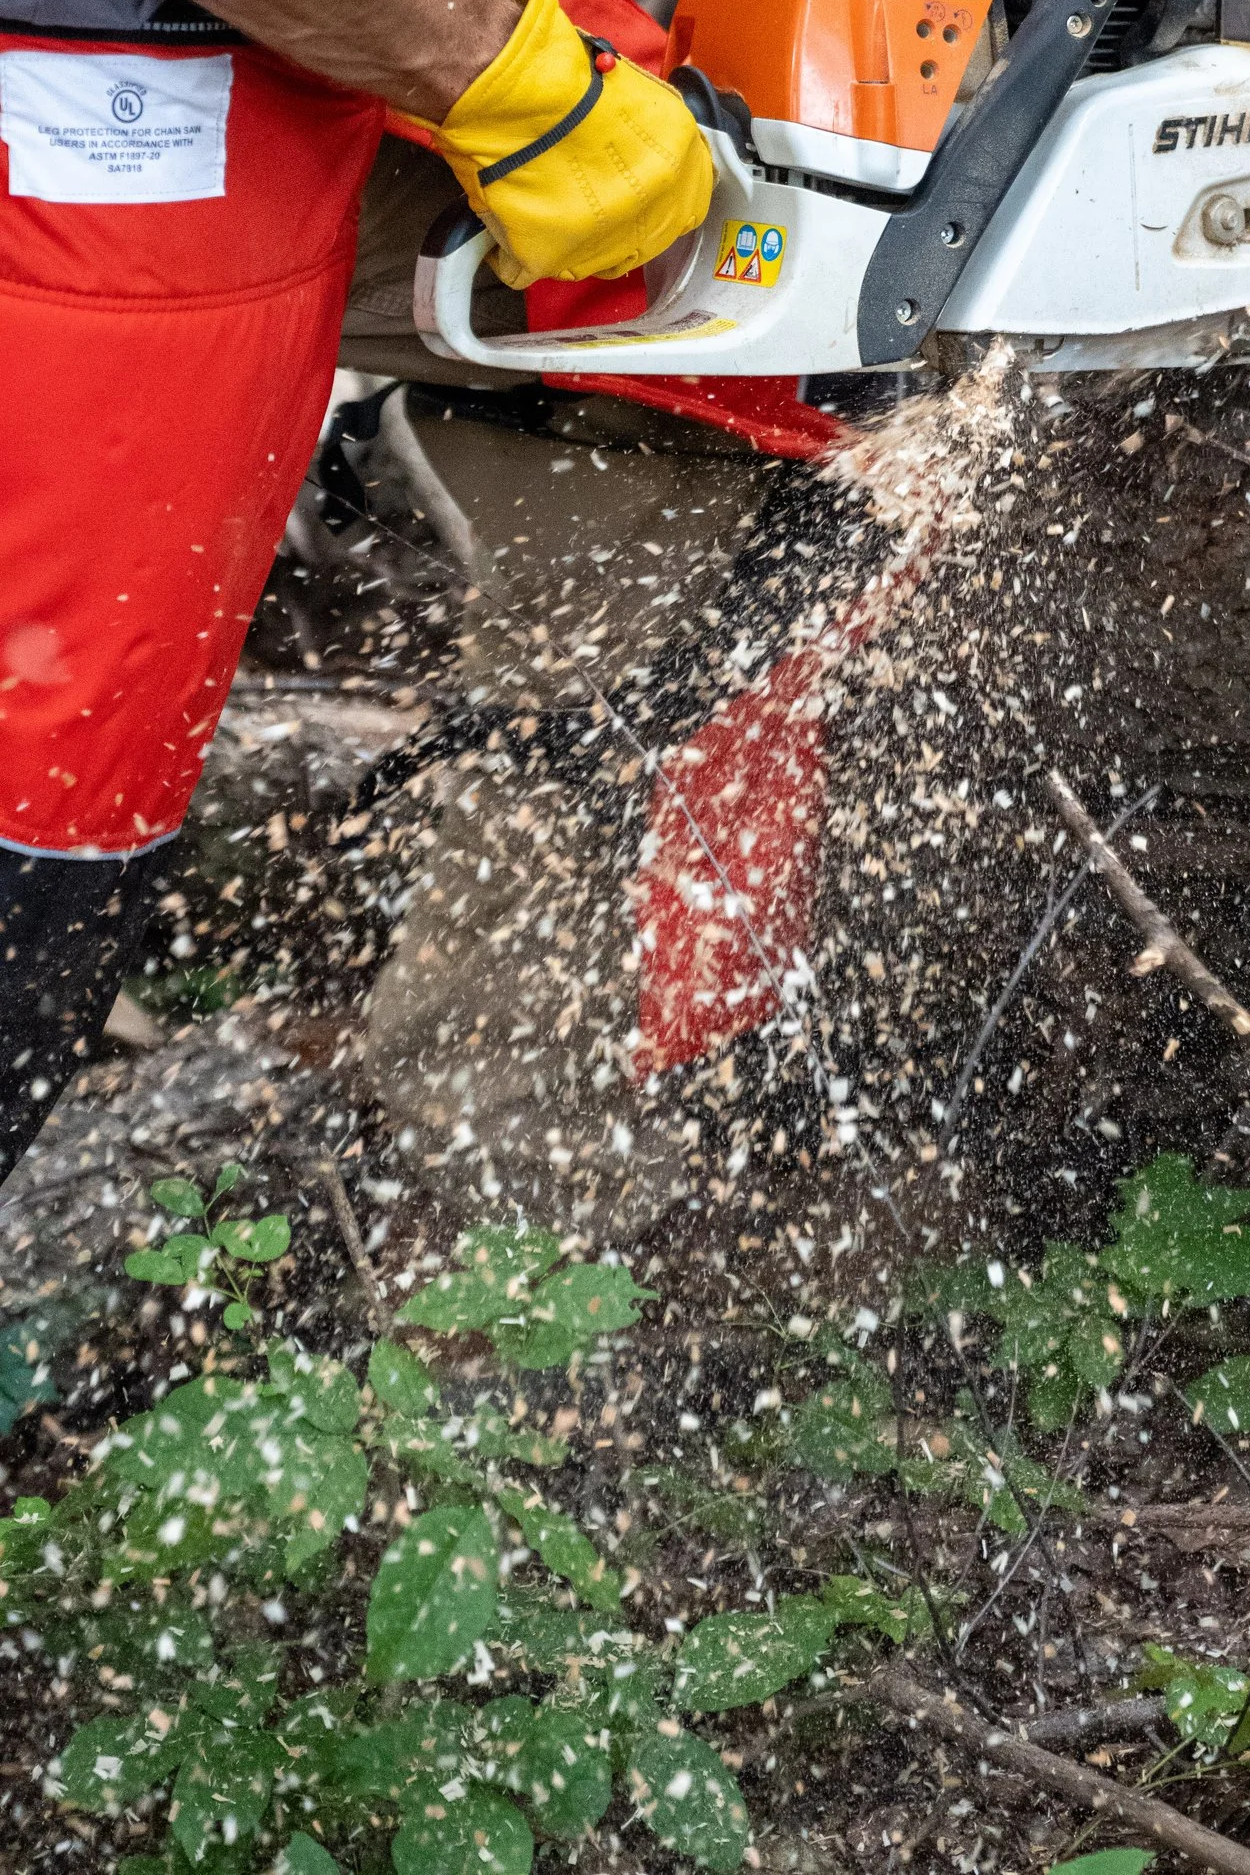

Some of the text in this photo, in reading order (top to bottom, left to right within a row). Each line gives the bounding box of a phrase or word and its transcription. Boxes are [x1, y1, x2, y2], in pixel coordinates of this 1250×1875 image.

[119, 97, 136, 116] UL
[38, 125, 202, 137] LEG PROTECTION FOR CHAIN SAW
[49, 137, 194, 149] USERS IN ACCORDANCE WITH
[88, 152, 117, 161] ASTM
